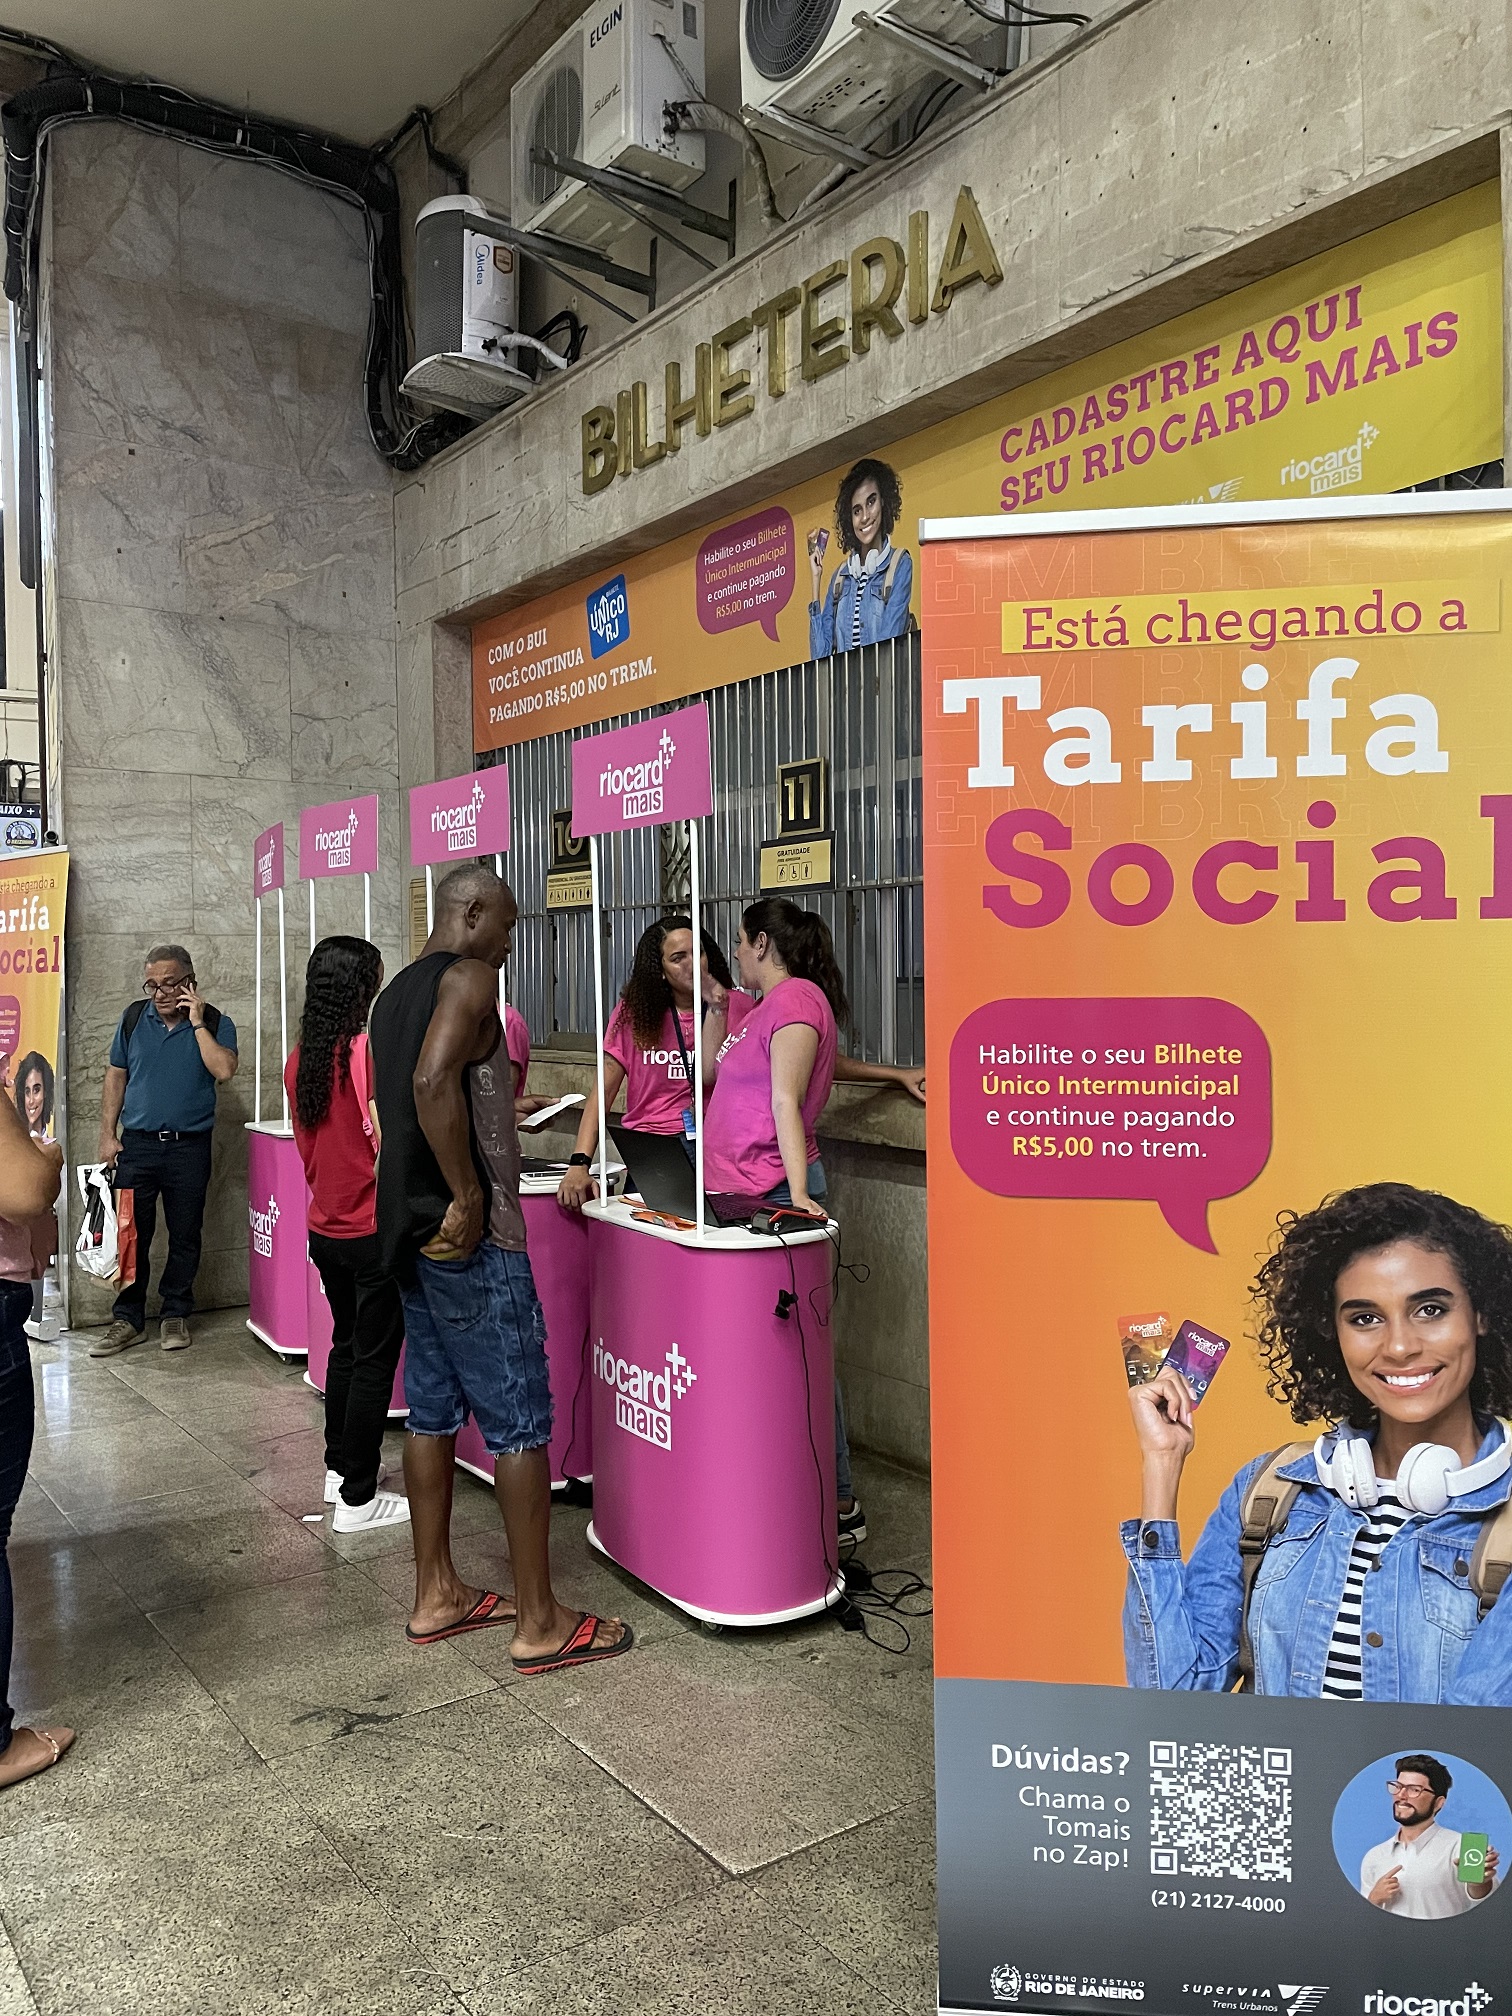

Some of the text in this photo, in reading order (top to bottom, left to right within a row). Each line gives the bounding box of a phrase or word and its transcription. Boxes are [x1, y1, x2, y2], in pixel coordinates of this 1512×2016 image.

[590, 3, 622, 48] ELGIN
[475, 244, 490, 285] Midea
[581, 185, 1004, 496] BILHETERIA
[999, 285, 1363, 463] CADASTRE AQUI
[1000, 310, 1459, 511] SEU RIOCARD MAIS
[1280, 437, 1362, 486] riocard
[1312, 464, 1361, 494] mais
[704, 524, 787, 565] Habilite o seu Bilhete
[705, 542, 787, 584] Único Intermunicipal
[707, 565, 786, 603] e continue pagando
[590, 594, 625, 633] ÚNICO
[716, 591, 777, 619] R$5,00 no trem.
[1022, 589, 1468, 651] Está chegando a
[488, 627, 548, 665] COM O BUI
[605, 618, 619, 643] RJ
[488, 647, 584, 695] VOCÊ CONTINUA
[489, 656, 657, 724] PAGANDO R$5,00 NO TREM.
[943, 657, 1449, 788] Tarifa
[599, 750, 663, 798] riocard
[625, 788, 661, 817] mais
[784, 774, 811, 821] 11
[431, 797, 476, 833] riocard
[315, 823, 351, 851] riocard
[449, 828, 476, 849] mais
[555, 820, 584, 856] 10
[777, 847, 810, 857] GRATUIDADE
[328, 849, 350, 866] mais
[983, 795, 1512, 929] Social
[0, 876, 55, 894] stá chegando a
[0, 895, 49, 933] arifa
[0, 935, 60, 974] ocial
[979, 1043, 1242, 1065] Habilite o seu Bilhete
[982, 1070, 1239, 1100] Único Intermunicipal
[986, 1106, 1235, 1132] e continue pagando
[1013, 1135, 1207, 1158] R$5,00 no trem.
[254, 1233, 271, 1255] mais
[1129, 1320, 1161, 1333] riocard
[1187, 1331, 1218, 1353] riocard
[593, 1337, 671, 1412] riocard
[618, 1397, 669, 1445] mais
[991, 1743, 1130, 1776] Dúvidas?
[1018, 1785, 1131, 1814] Chama o
[1043, 1815, 1131, 1841] Tomais
[1033, 1844, 1129, 1871] no Zap!
[1151, 1889, 1286, 1914] (21) 2127-4000
[1025, 1973, 1145, 1988] GOVERNO DO ESTADO
[1025, 1981, 1145, 2001] RIO DE JANEIRO
[1212, 2000, 1278, 2013] Trens Urbanos
[1364, 1989, 1470, 2016] riocard
